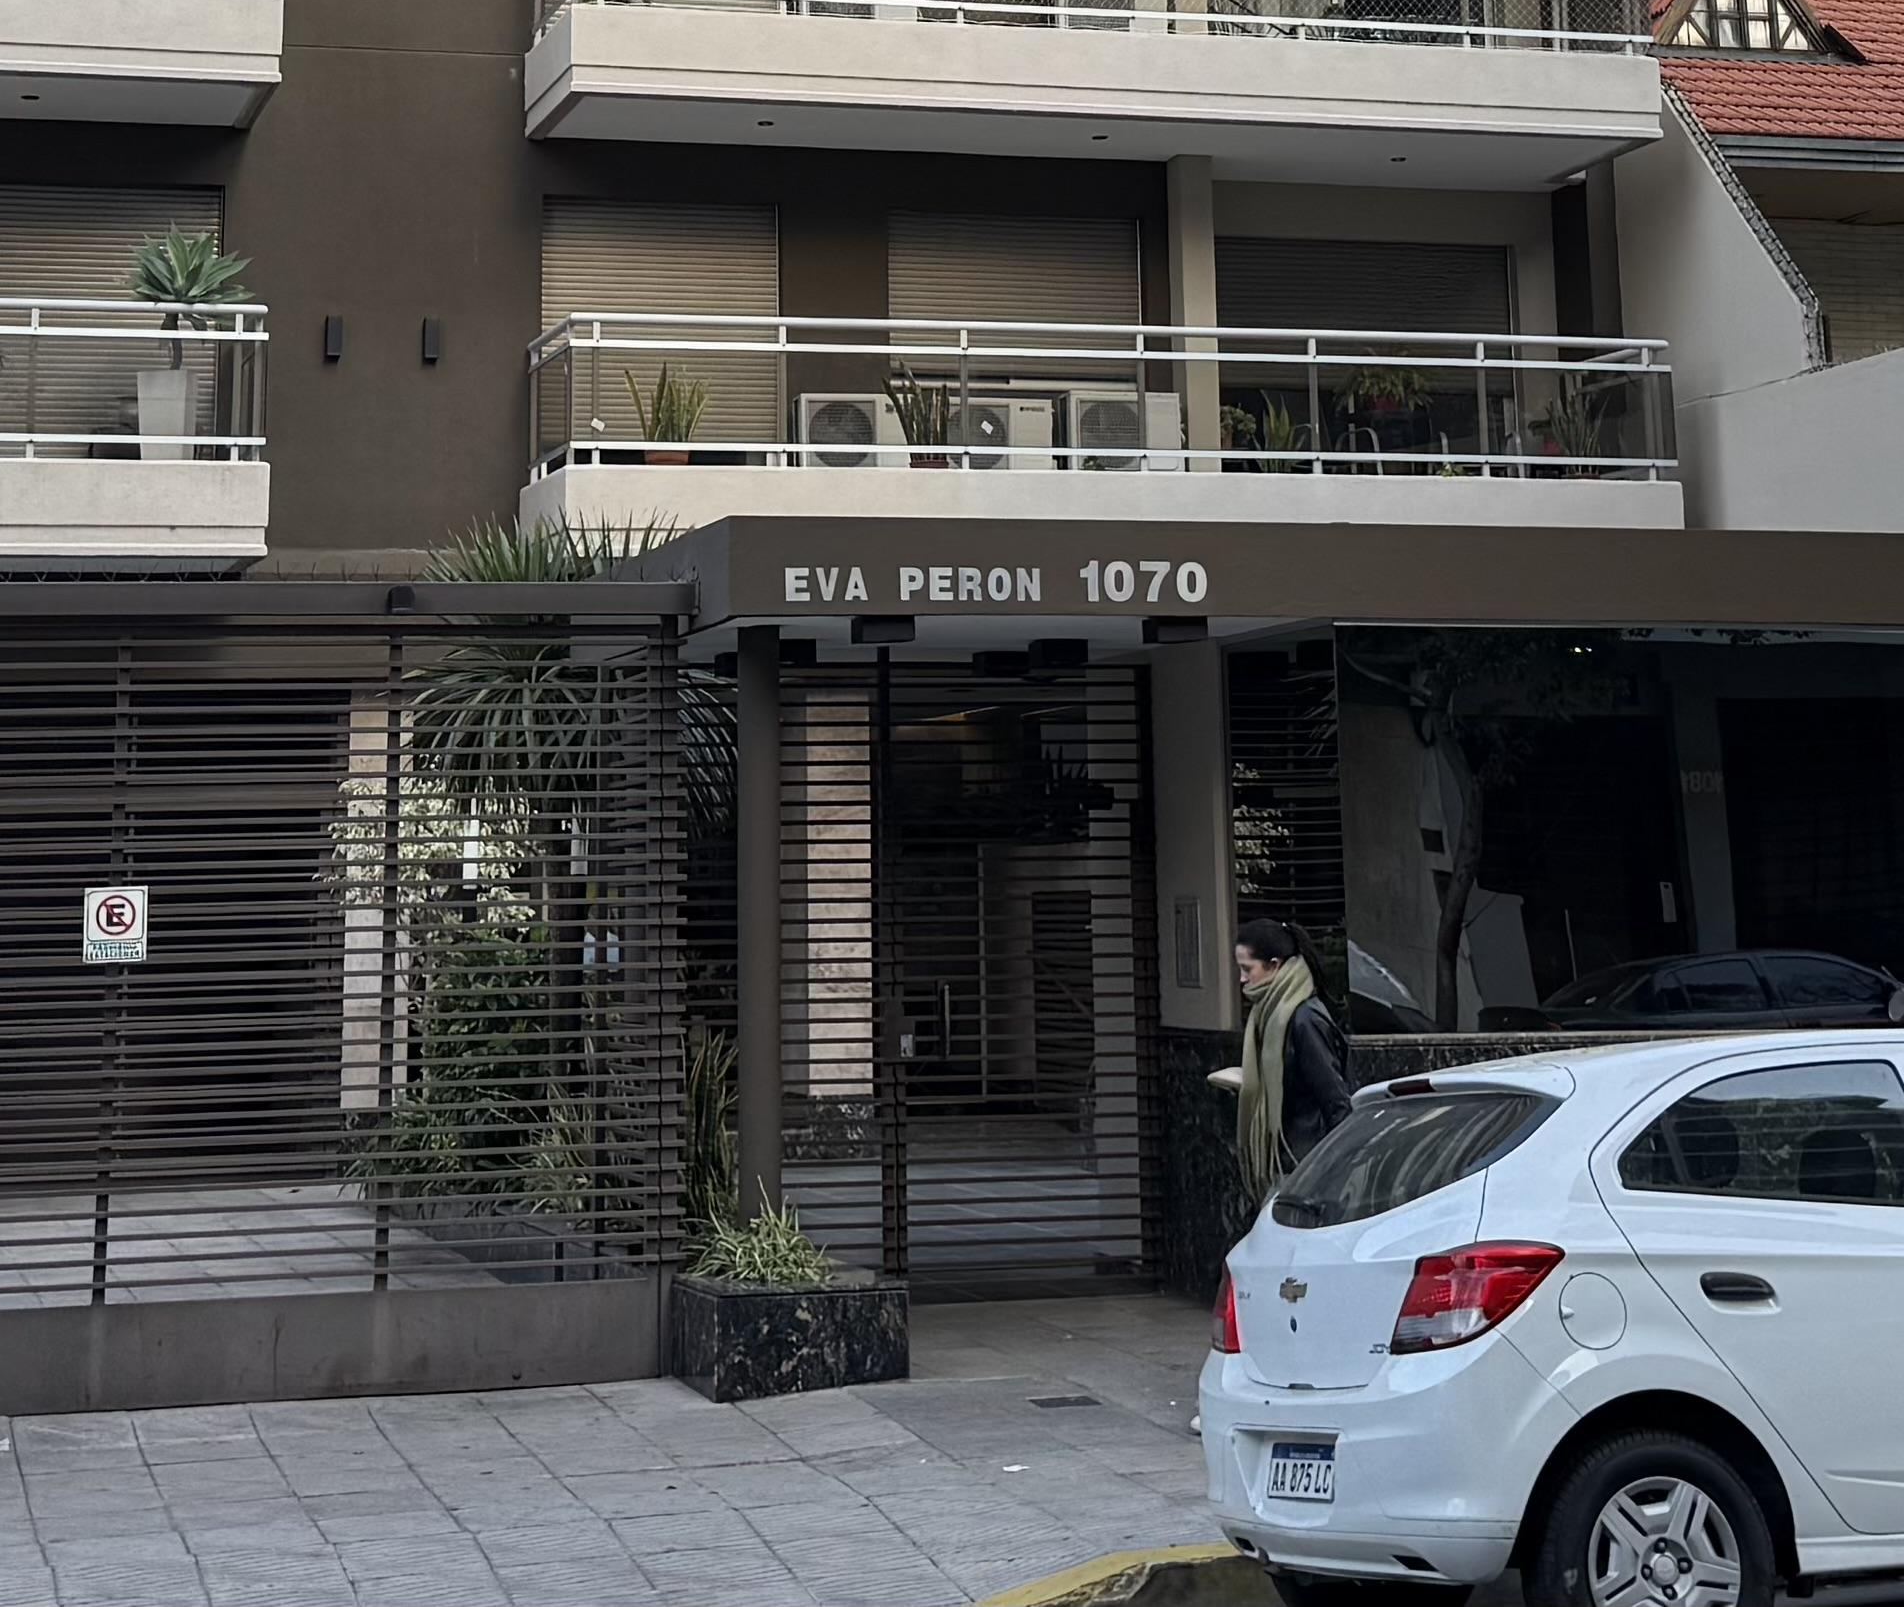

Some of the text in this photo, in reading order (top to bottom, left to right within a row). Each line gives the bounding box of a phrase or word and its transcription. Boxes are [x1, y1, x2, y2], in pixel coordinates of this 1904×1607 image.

[783, 559, 1208, 603] EVA PERON 1070
[106, 903, 127, 927] E
[1271, 1461, 1287, 1491] AA
[1289, 1462, 1314, 1492] 875
